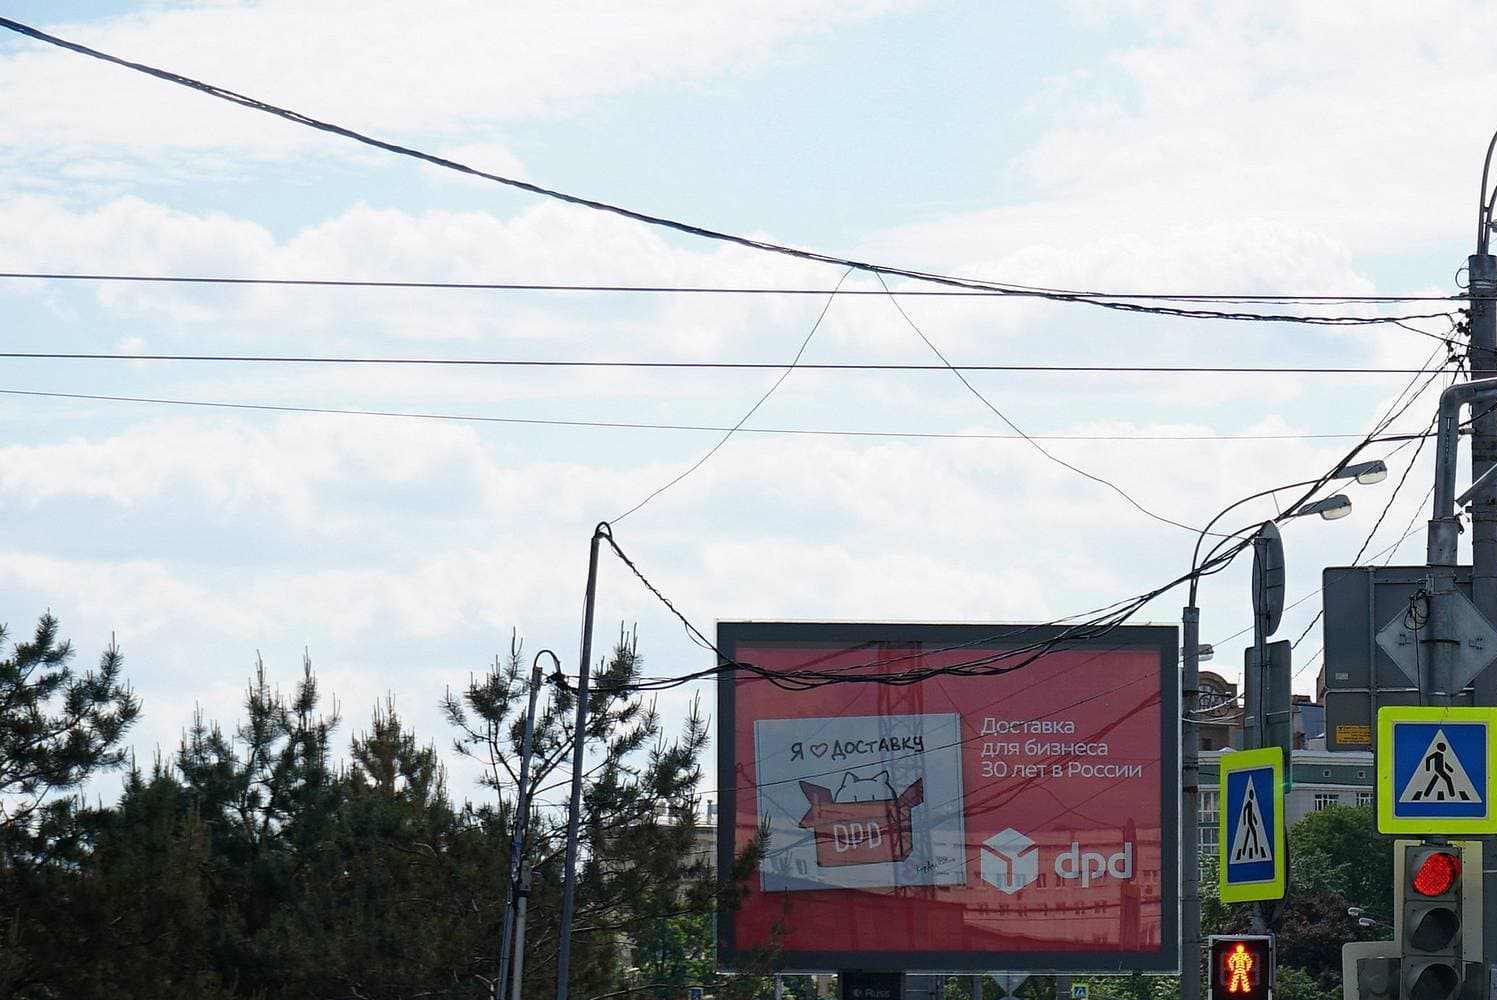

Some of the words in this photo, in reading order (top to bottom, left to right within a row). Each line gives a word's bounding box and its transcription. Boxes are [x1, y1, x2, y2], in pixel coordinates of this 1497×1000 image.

[981, 718, 1075, 736] Доставка
[791, 743, 804, 761] Я
[832, 736, 924, 760] ДОСТАВКУ
[981, 743, 1020, 757] для
[1025, 739, 1108, 756] бизнеса
[981, 762, 1007, 777] 30
[1011, 765, 1048, 778] лет
[1053, 766, 1063, 777] в
[1068, 762, 1142, 778] России
[834, 822, 882, 852] DPD
[1055, 842, 1132, 888] dpd
